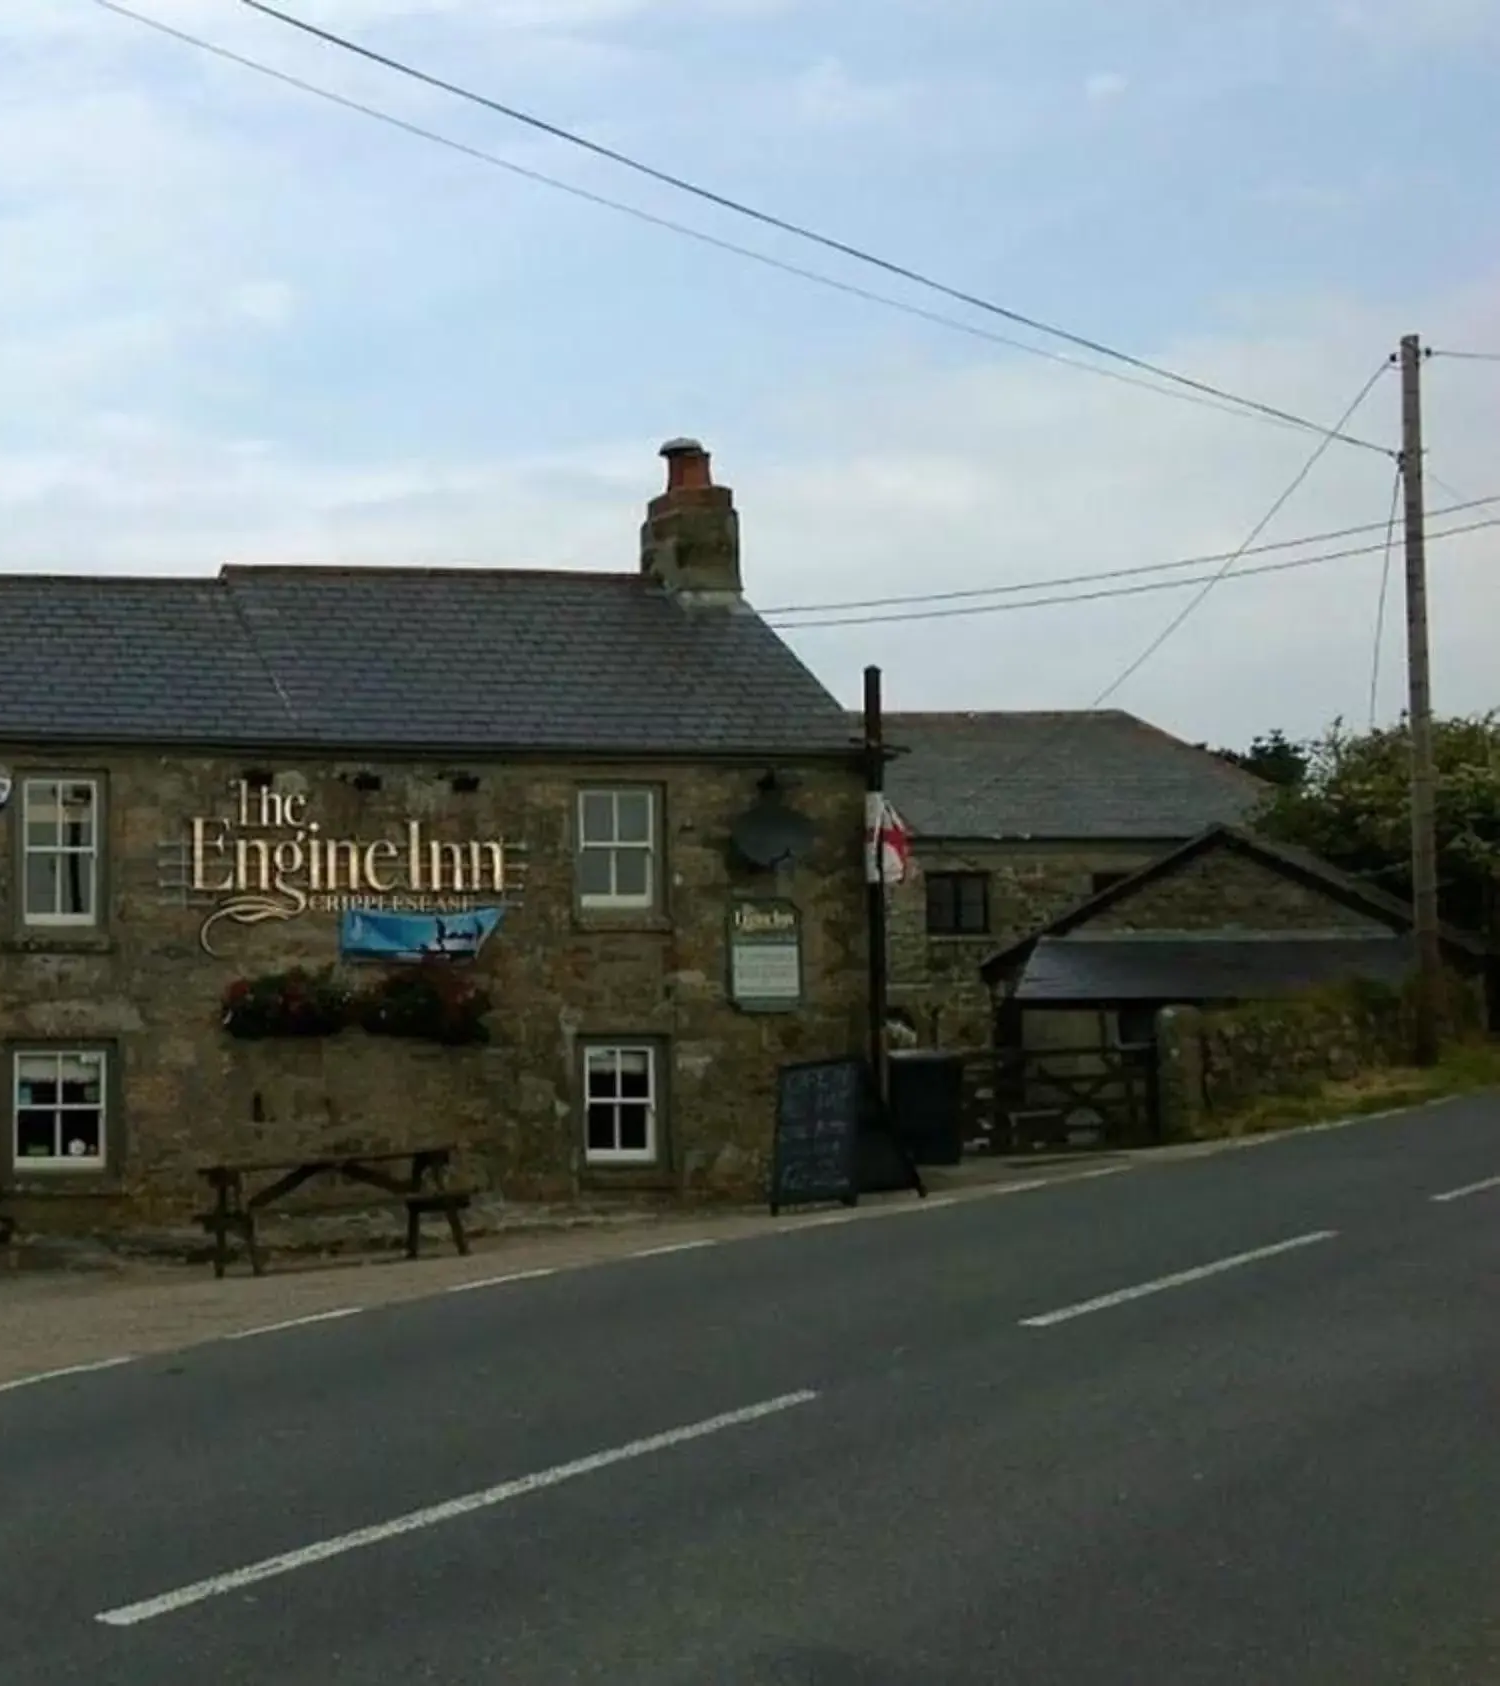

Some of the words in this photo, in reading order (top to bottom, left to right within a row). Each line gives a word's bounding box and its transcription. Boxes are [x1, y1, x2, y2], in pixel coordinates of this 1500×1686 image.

[230, 779, 306, 828] The
[191, 816, 398, 923] Engine
[409, 819, 505, 892] Inn
